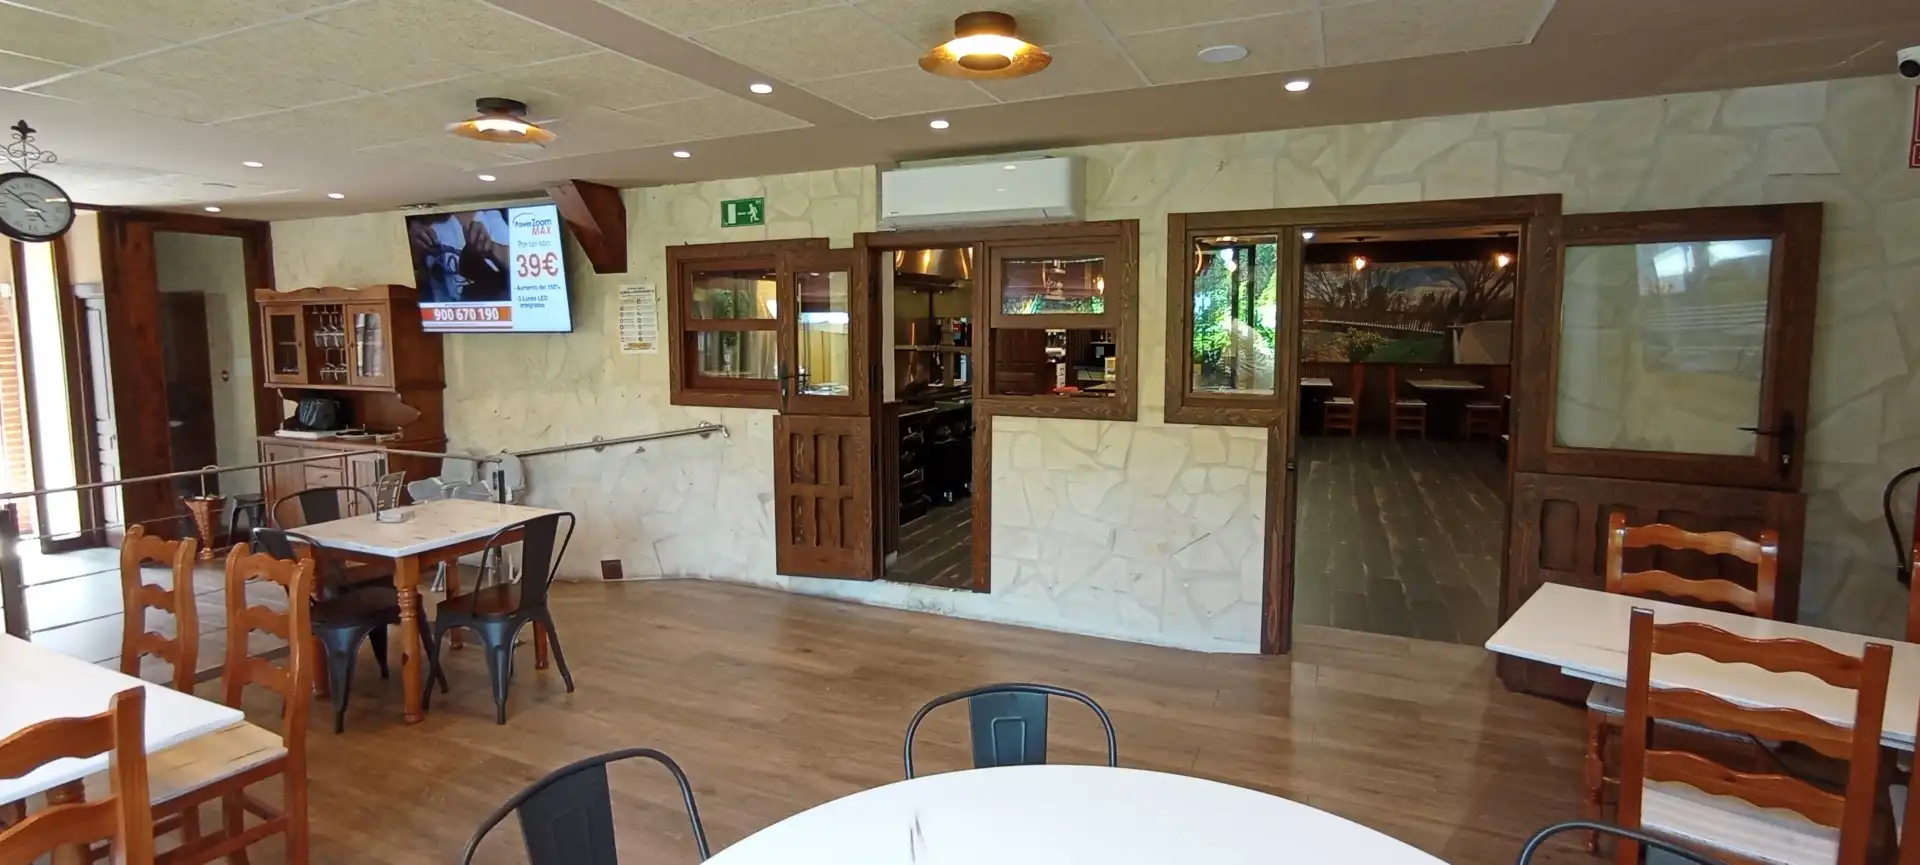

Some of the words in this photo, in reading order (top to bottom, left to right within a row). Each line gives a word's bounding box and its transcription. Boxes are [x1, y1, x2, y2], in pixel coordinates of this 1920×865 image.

[531, 227, 552, 236] MAX
[516, 252, 559, 278] 39€
[434, 308, 454, 321] 900
[456, 308, 476, 321] 670
[478, 307, 499, 320] 190
